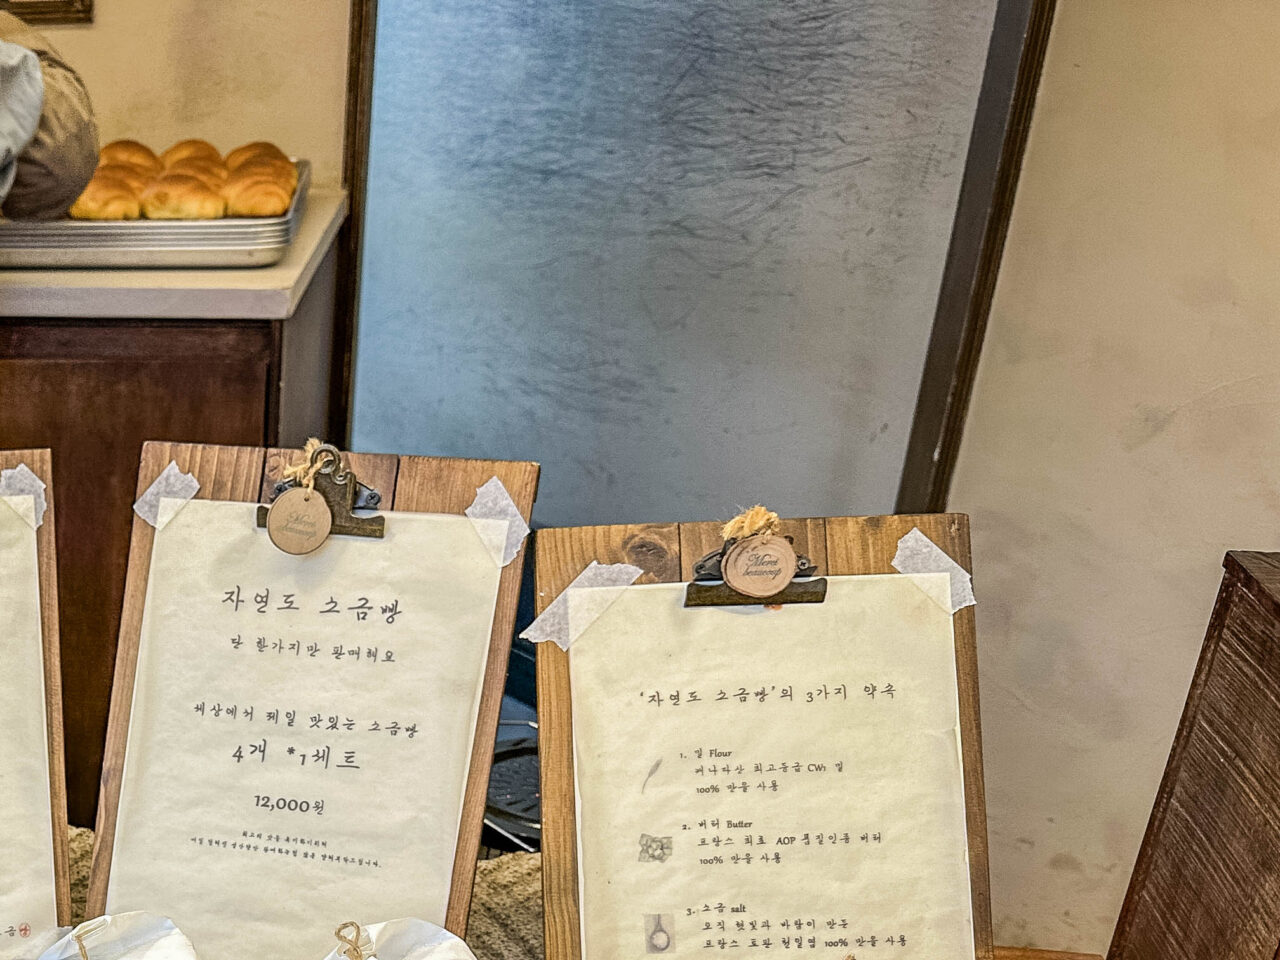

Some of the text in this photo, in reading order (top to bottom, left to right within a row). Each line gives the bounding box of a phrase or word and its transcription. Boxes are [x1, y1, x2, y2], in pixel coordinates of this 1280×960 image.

[221, 584, 403, 625] 자연도 소금빵
[230, 633, 244, 650] 단
[331, 644, 396, 664] 판매해요
[805, 683, 847, 703] 3가지
[863, 682, 897, 700] 약속
[193, 701, 419, 739] 세상에서 제일 맛있는 소금빵
[231, 738, 267, 764] 4개
[708, 748, 733, 758] Flour
[696, 784, 721, 794] 100%
[756, 779, 779, 792] 사용
[254, 795, 325, 816] 12,000원
[726, 819, 753, 829] Butter
[699, 855, 724, 865] 100%
[760, 851, 782, 865] 사용
[730, 903, 747, 913] salt
[824, 937, 849, 948] 100%
